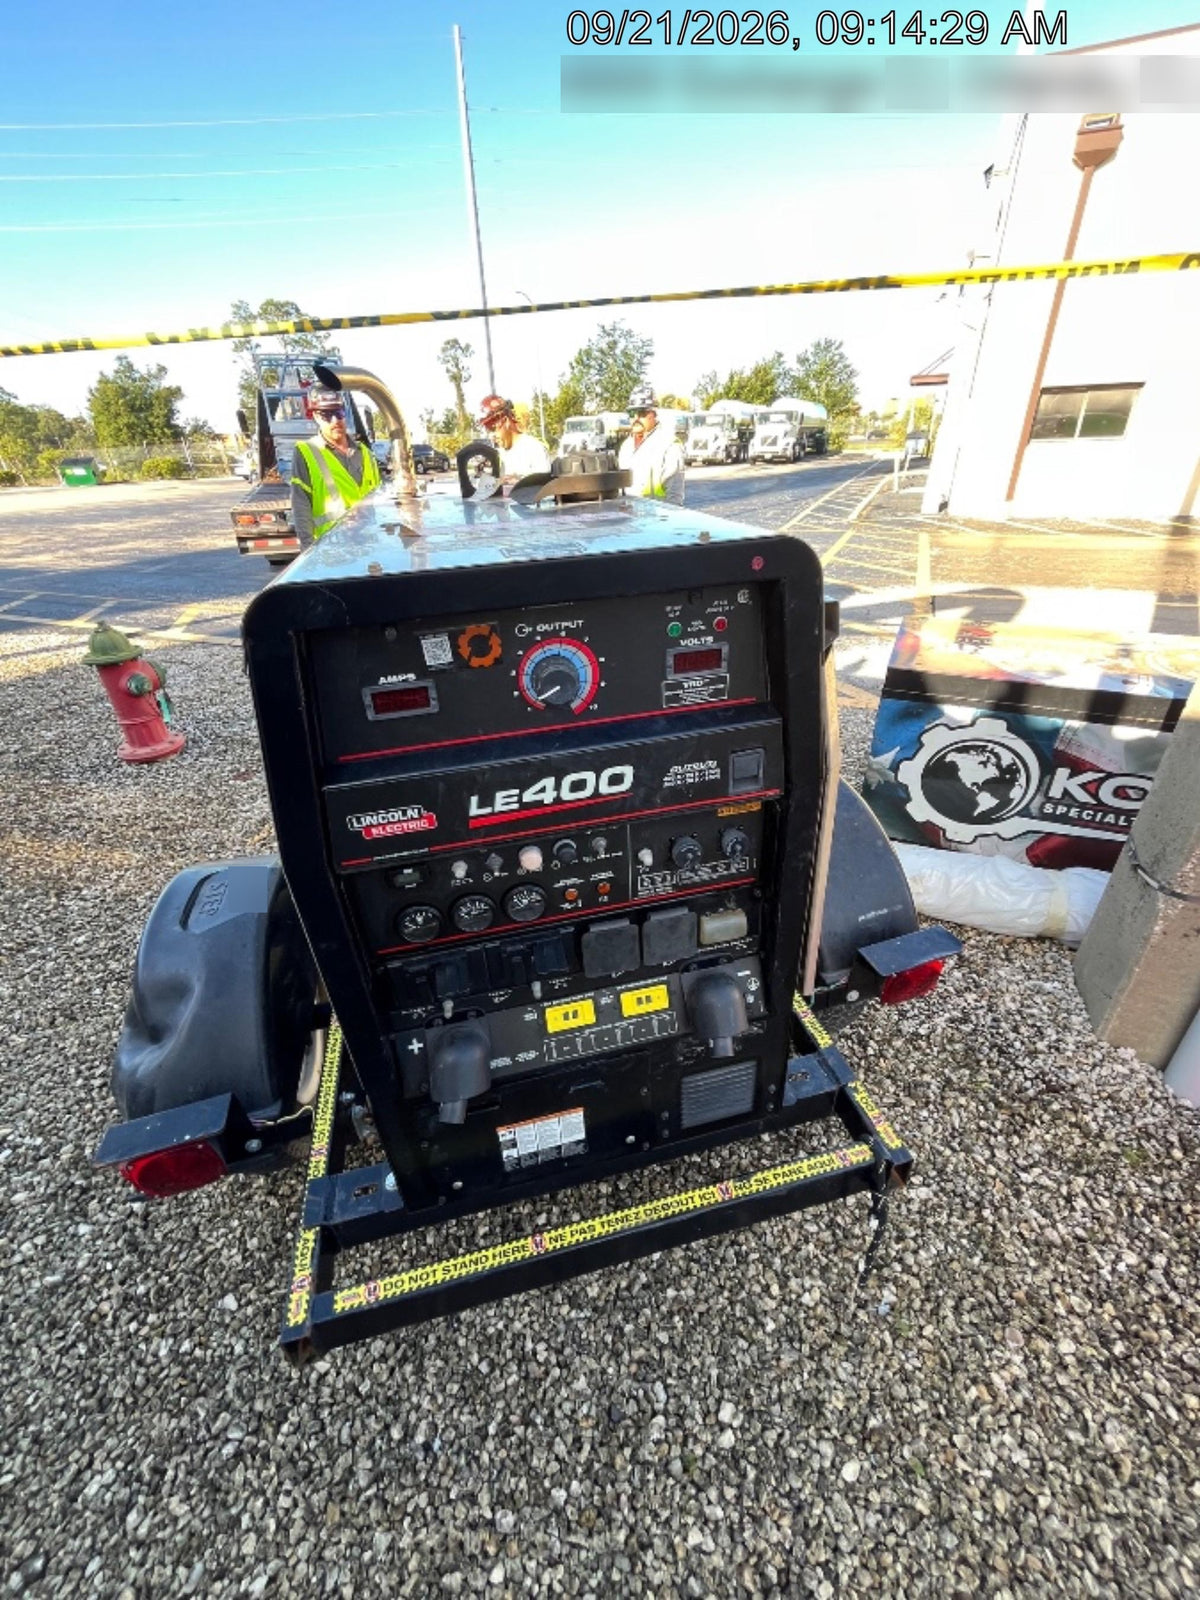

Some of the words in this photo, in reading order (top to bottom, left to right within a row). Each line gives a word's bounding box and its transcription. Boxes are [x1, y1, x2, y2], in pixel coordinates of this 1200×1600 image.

[536, 620, 584, 632] OUTPUT
[680, 636, 714, 646] VOLTS
[378, 673, 416, 685] AMPS
[469, 764, 635, 816] LE400
[352, 808, 420, 828] LINCOLN
[370, 819, 430, 835] ELECTRIC
[734, 1180, 753, 1192] NO
[753, 1175, 771, 1187] SE
[772, 1165, 805, 1182] PARE
[548, 1233, 568, 1244] NE
[570, 1225, 597, 1240] PAS
[600, 1211, 641, 1231] TENEZ
[643, 1195, 696, 1217] DEBOUT
[383, 1279, 404, 1292] DO
[408, 1269, 438, 1286] NOT
[441, 1253, 489, 1277] STAND
[491, 1244, 530, 1261] HERE
